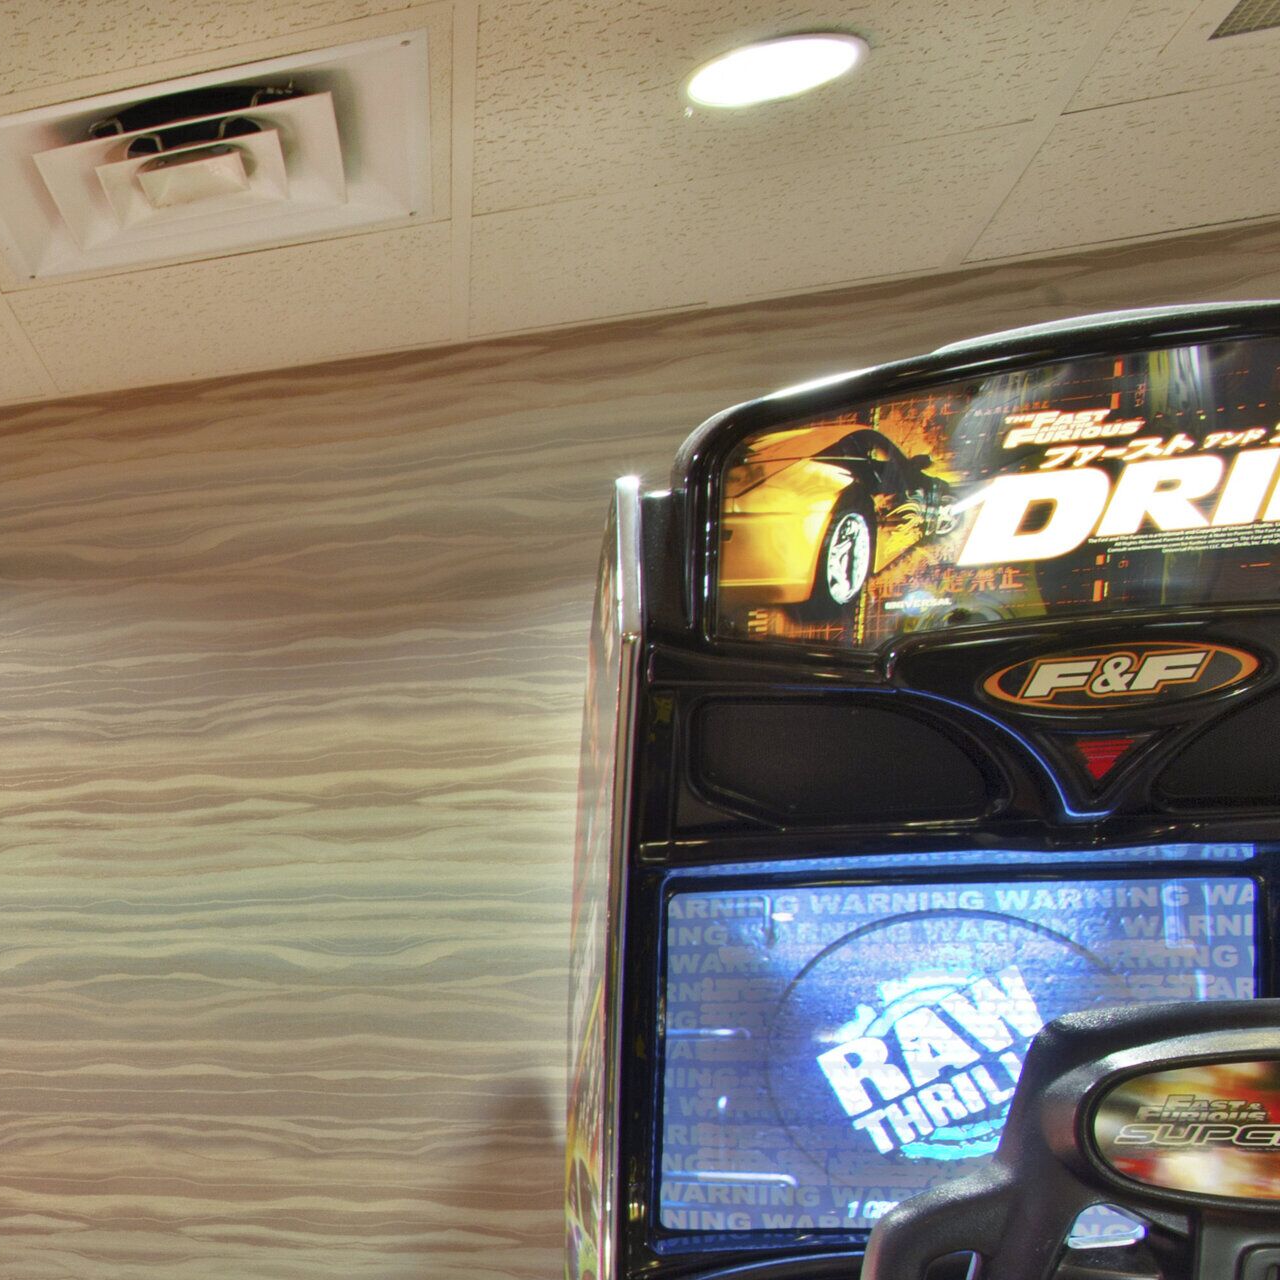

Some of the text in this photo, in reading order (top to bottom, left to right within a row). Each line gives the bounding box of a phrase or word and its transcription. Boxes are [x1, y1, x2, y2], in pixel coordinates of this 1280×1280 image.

[1028, 409, 1111, 429] FAST
[1003, 420, 1146, 449] FURIOUS
[956, 448, 1280, 566] DRI
[1022, 649, 1216, 701] F&F
[810, 889, 985, 915] WARNING
[996, 884, 1189, 911] WARNING
[816, 964, 1044, 1117] RAW
[1136, 1104, 1268, 1123] FURIOUS
[1161, 1093, 1247, 1112] FAST
[1113, 1123, 1280, 1147] SUPE
